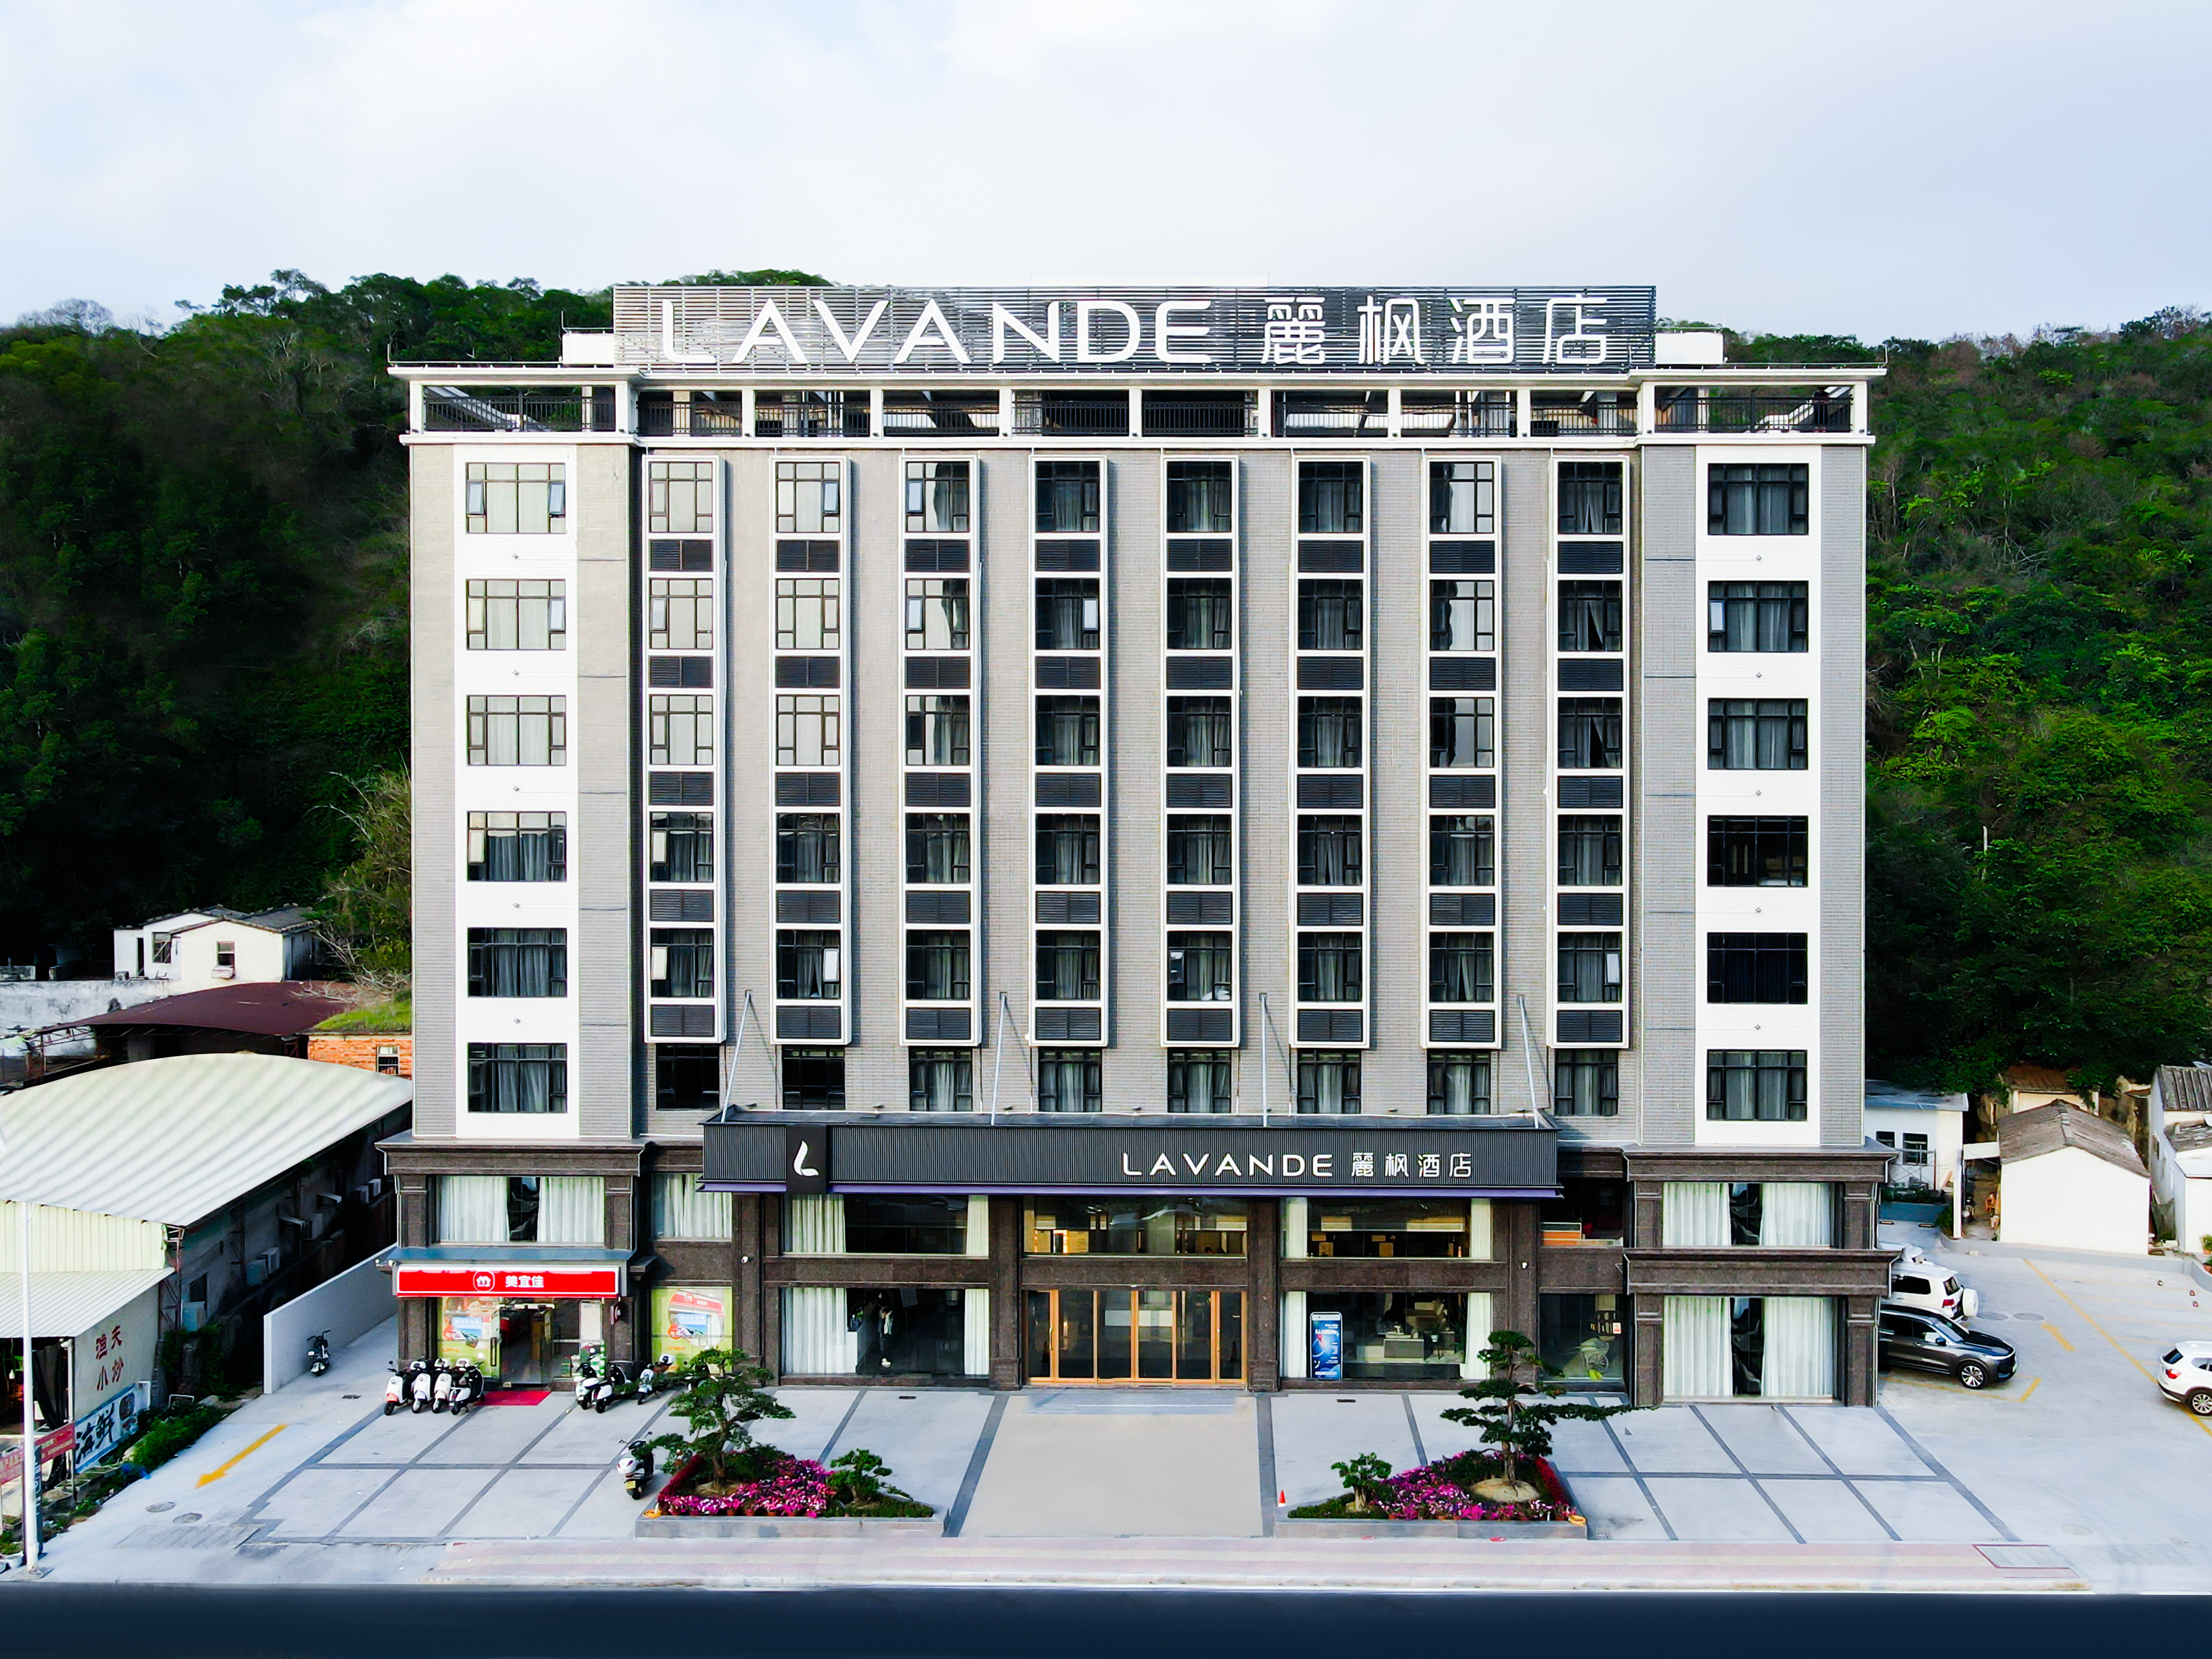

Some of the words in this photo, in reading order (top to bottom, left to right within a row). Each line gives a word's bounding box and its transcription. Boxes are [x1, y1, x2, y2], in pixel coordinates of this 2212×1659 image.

[662, 298, 1213, 364] LAVANDE
[1261, 294, 1608, 365] 麗枫酒店
[1123, 1152, 1333, 1176] LAVANDE
[1351, 1152, 1472, 1178] 麗枫酒店
[505, 1275, 544, 1288] 美宜佳
[74, 1402, 115, 1465] 海鲜
